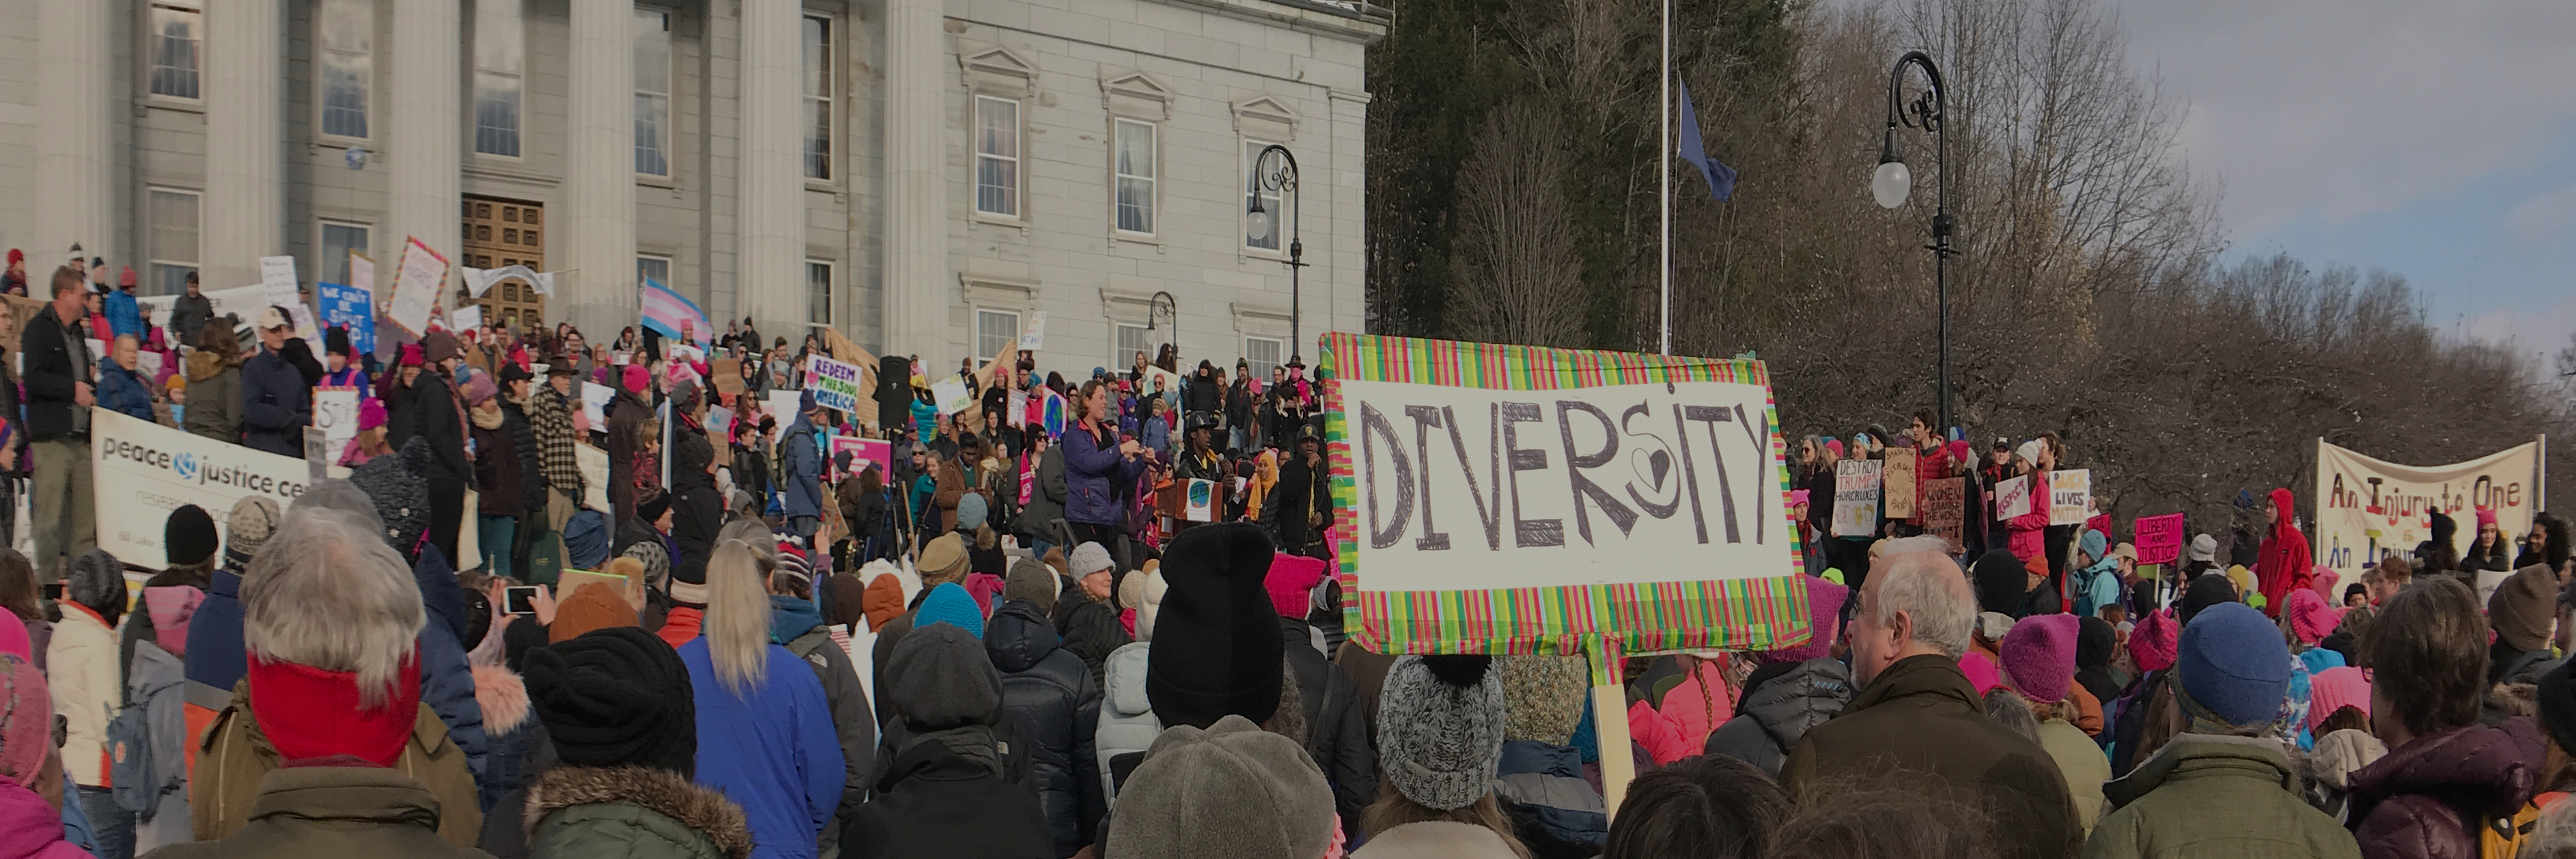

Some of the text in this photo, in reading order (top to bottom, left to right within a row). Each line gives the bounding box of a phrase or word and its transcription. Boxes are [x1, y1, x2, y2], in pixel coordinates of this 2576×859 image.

[322, 287, 368, 304] WE CAN'T
[339, 300, 352, 312] BE
[330, 309, 366, 327] SHUT
[815, 358, 856, 382] REDEEM
[819, 374, 858, 397] THE SOUL
[815, 389, 856, 411] AMERICA
[102, 437, 307, 498] peace justice ce
[1840, 460, 1879, 476] DESTROY
[1838, 474, 1878, 490] TRUMP'S
[1835, 489, 1879, 502] HORCRUXES
[1926, 487, 1961, 502] WOMEN
[1997, 479, 2026, 518] RESPECT
[2056, 492, 2085, 505] LIVES
[2329, 473, 2521, 529] An Injury to One
[1931, 501, 1960, 511] CHANGE
[2051, 506, 2085, 523] MATTER
[1924, 510, 1963, 522] THE WORLD
[2138, 517, 2177, 535] LIBERTY
[2151, 535, 2168, 544] AND
[2138, 544, 2177, 563] JUSTICE
[2329, 530, 2351, 569] An
